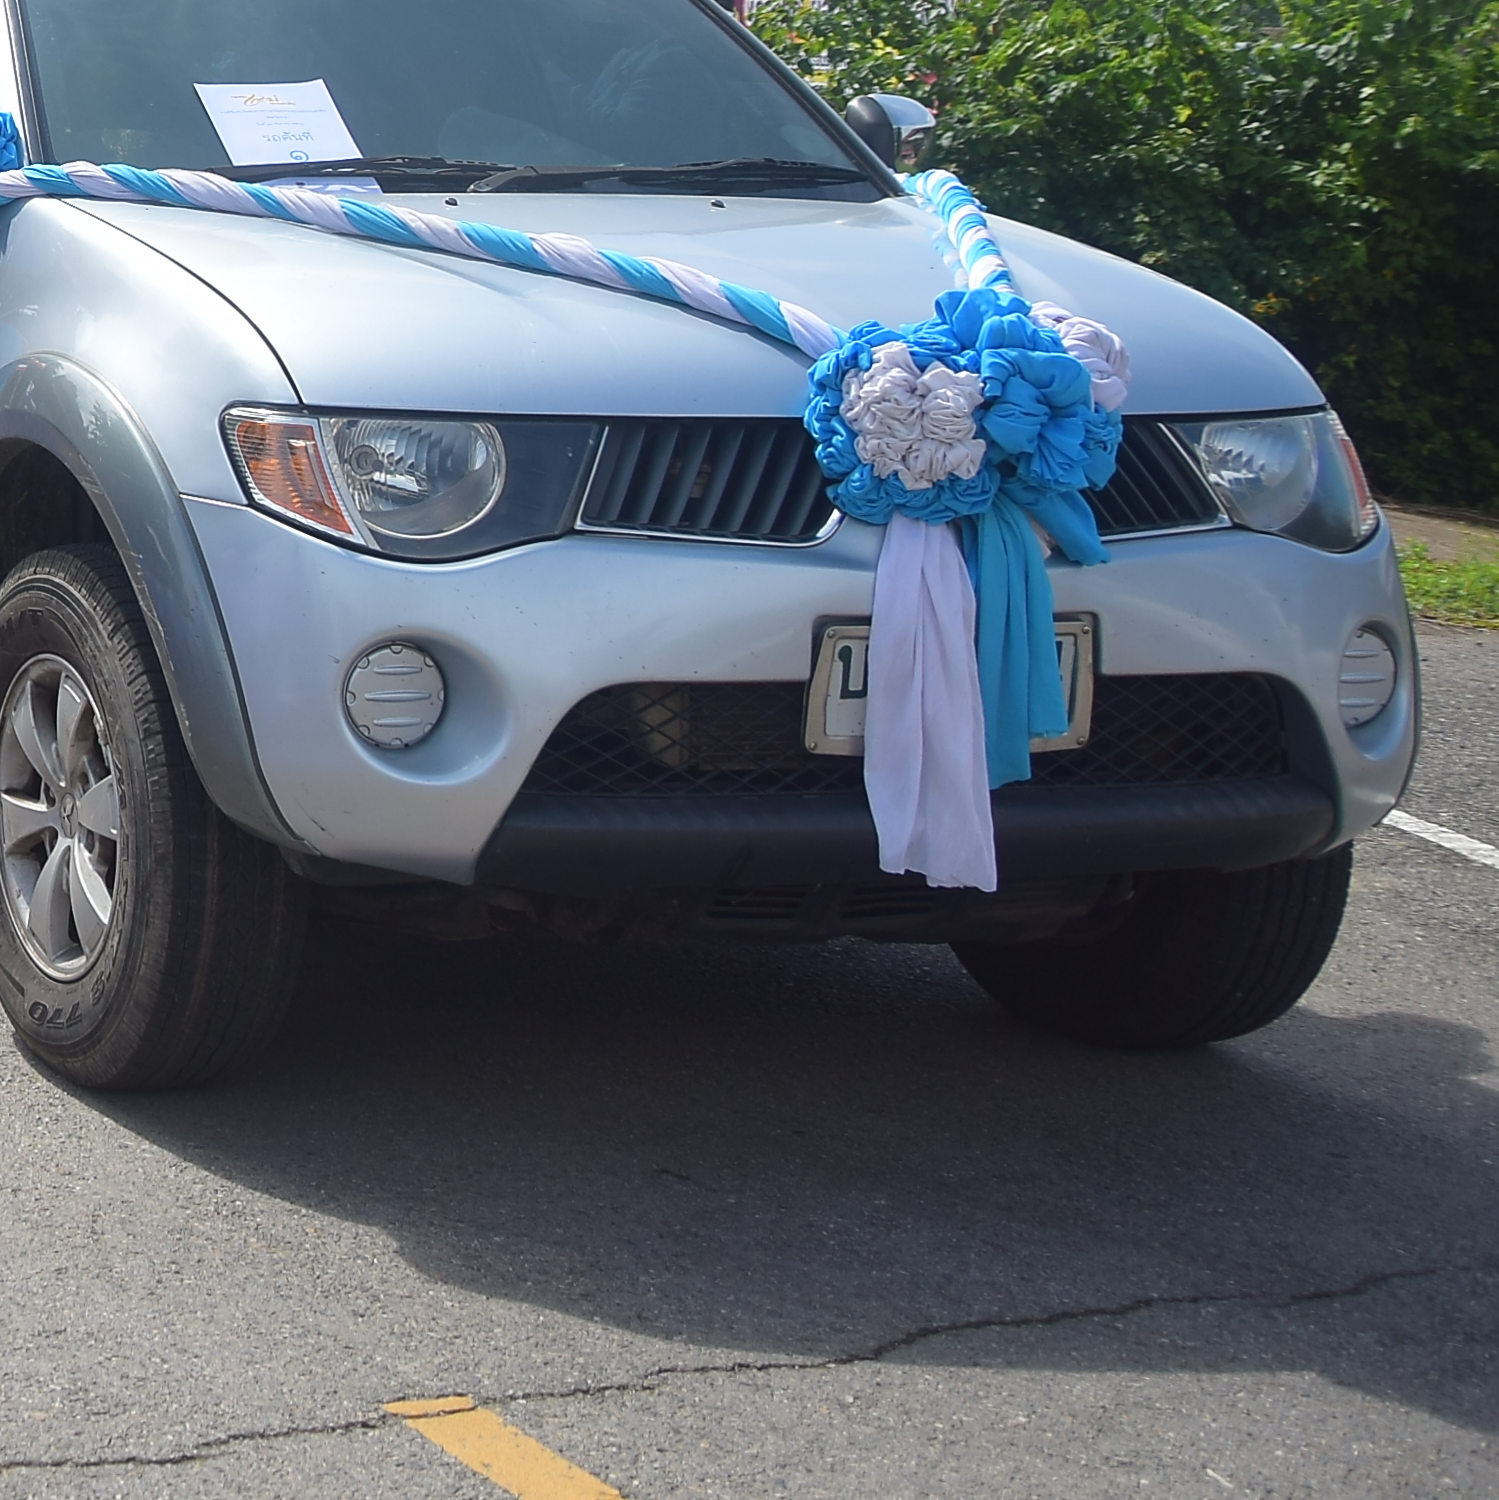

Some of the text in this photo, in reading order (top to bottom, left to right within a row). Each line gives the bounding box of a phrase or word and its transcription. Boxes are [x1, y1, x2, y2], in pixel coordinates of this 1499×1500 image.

[262, 129, 314, 142] รถคันที่
[28, 1000, 83, 1030] 770
